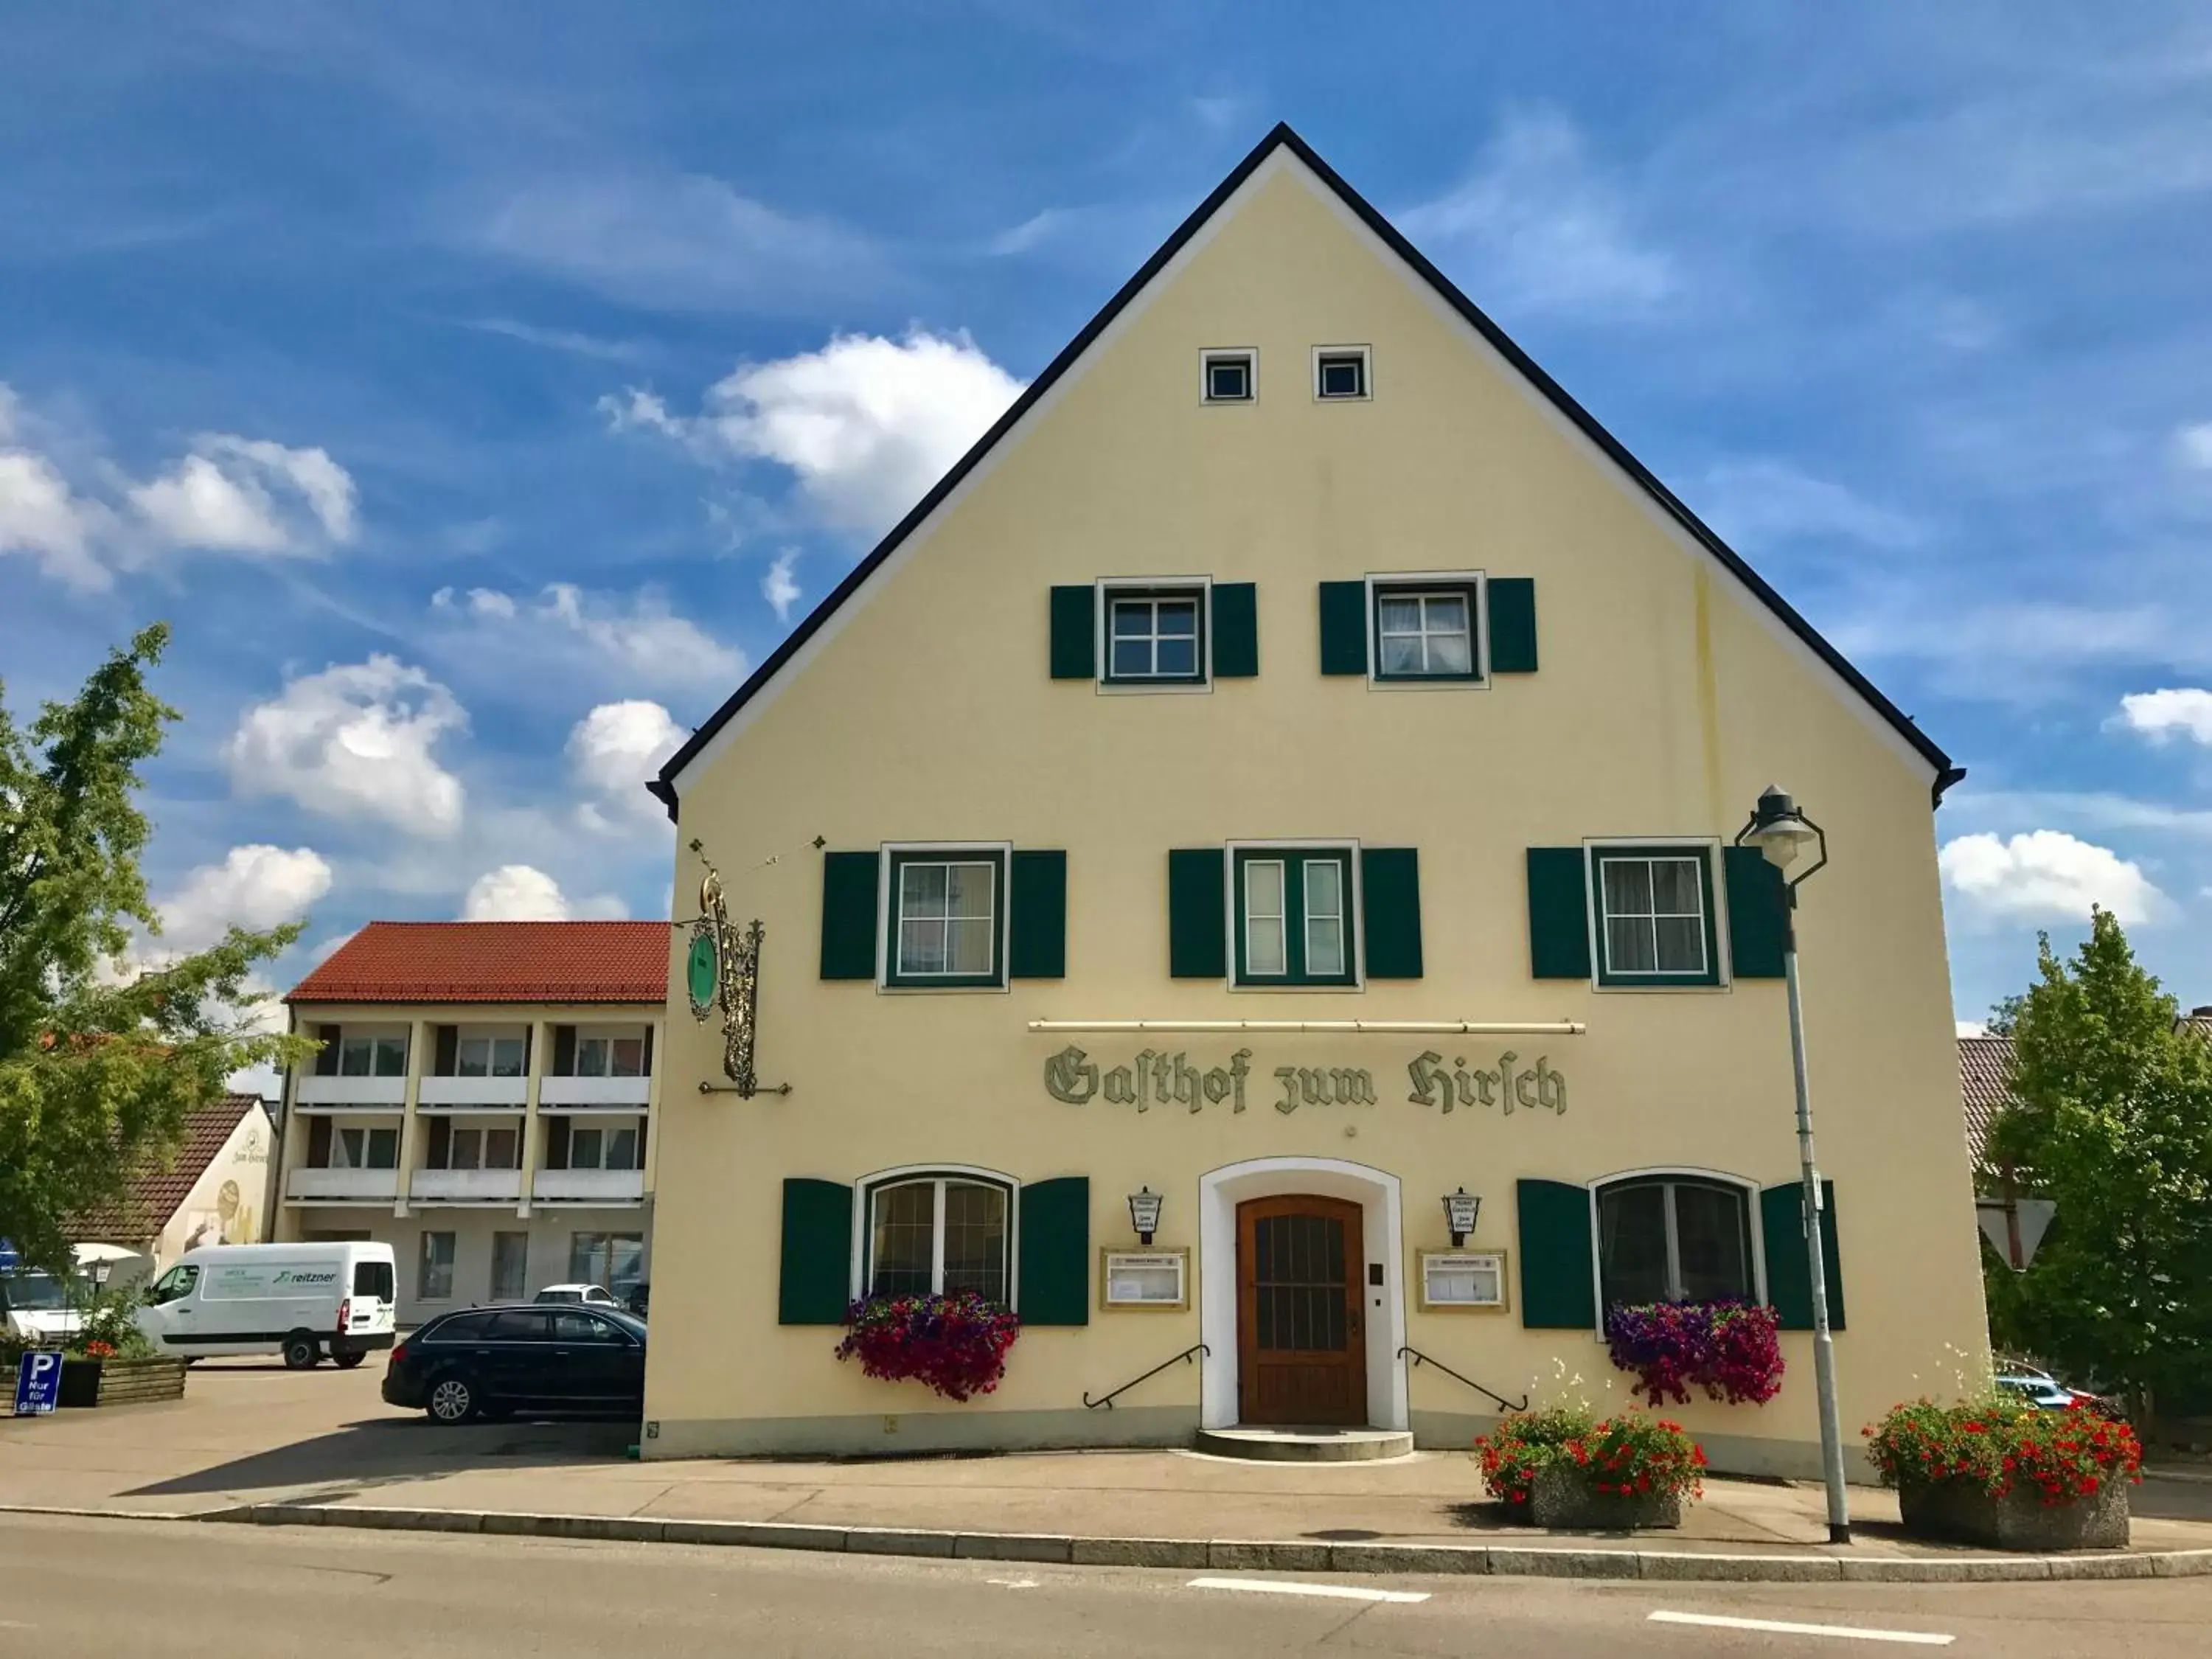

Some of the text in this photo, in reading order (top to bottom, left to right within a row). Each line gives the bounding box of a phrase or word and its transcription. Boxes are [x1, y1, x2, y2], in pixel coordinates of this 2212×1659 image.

[291, 1273, 337, 1284] reitzner
[30, 1354, 54, 1380] P
[29, 1381, 49, 1390] Nur
